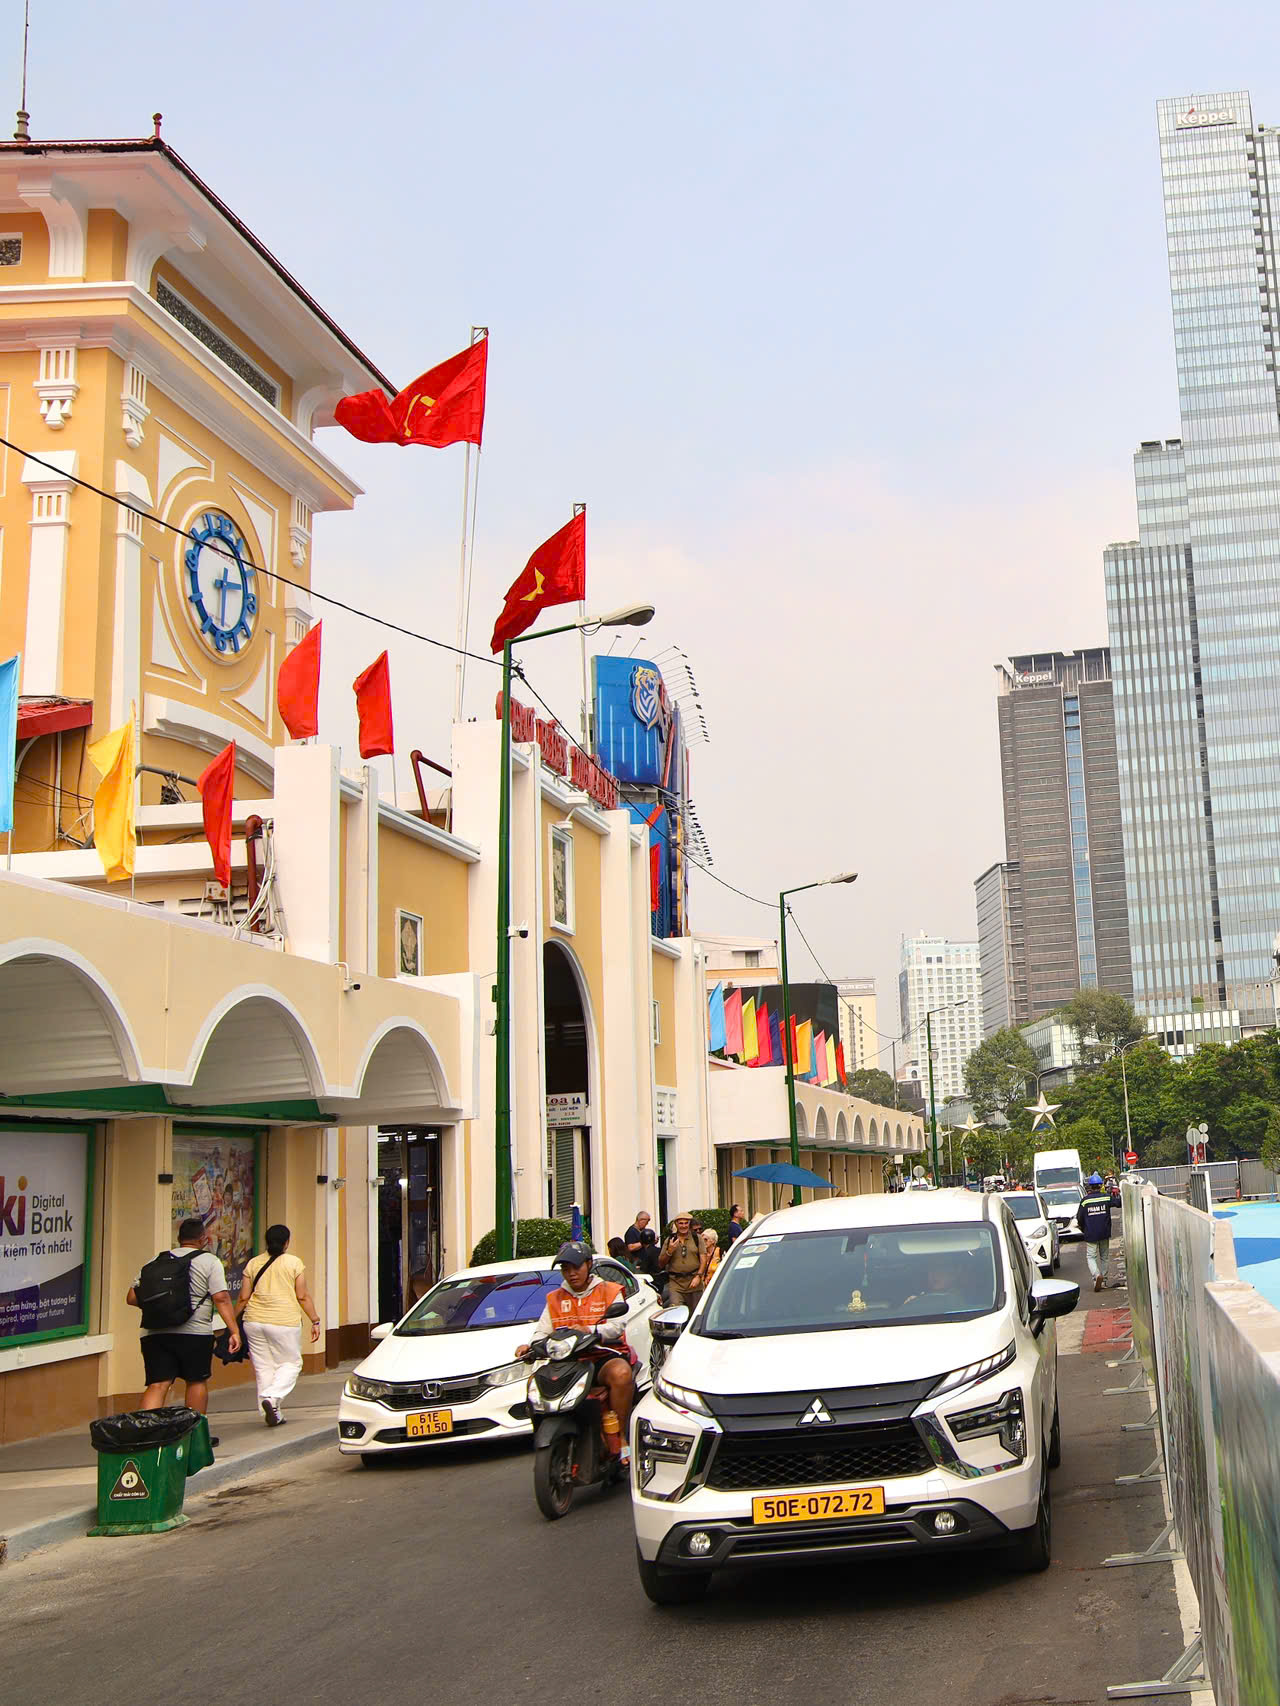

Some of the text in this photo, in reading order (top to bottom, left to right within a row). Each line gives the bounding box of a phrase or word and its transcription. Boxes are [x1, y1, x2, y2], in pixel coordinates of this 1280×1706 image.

[1177, 108, 1233, 126] Keppel
[1015, 671, 1052, 684] Keppel
[32, 1194, 65, 1211] Digital
[31, 1209, 73, 1235] Bank
[4, 1238, 72, 1261] kiệm Tốt nhất!
[20, 1312, 35, 1323] ignite
[36, 1311, 48, 1321] your
[420, 1412, 439, 1423] 61E
[412, 1422, 447, 1435] 011.50
[763, 1493, 873, 1519] 50E-072.72
